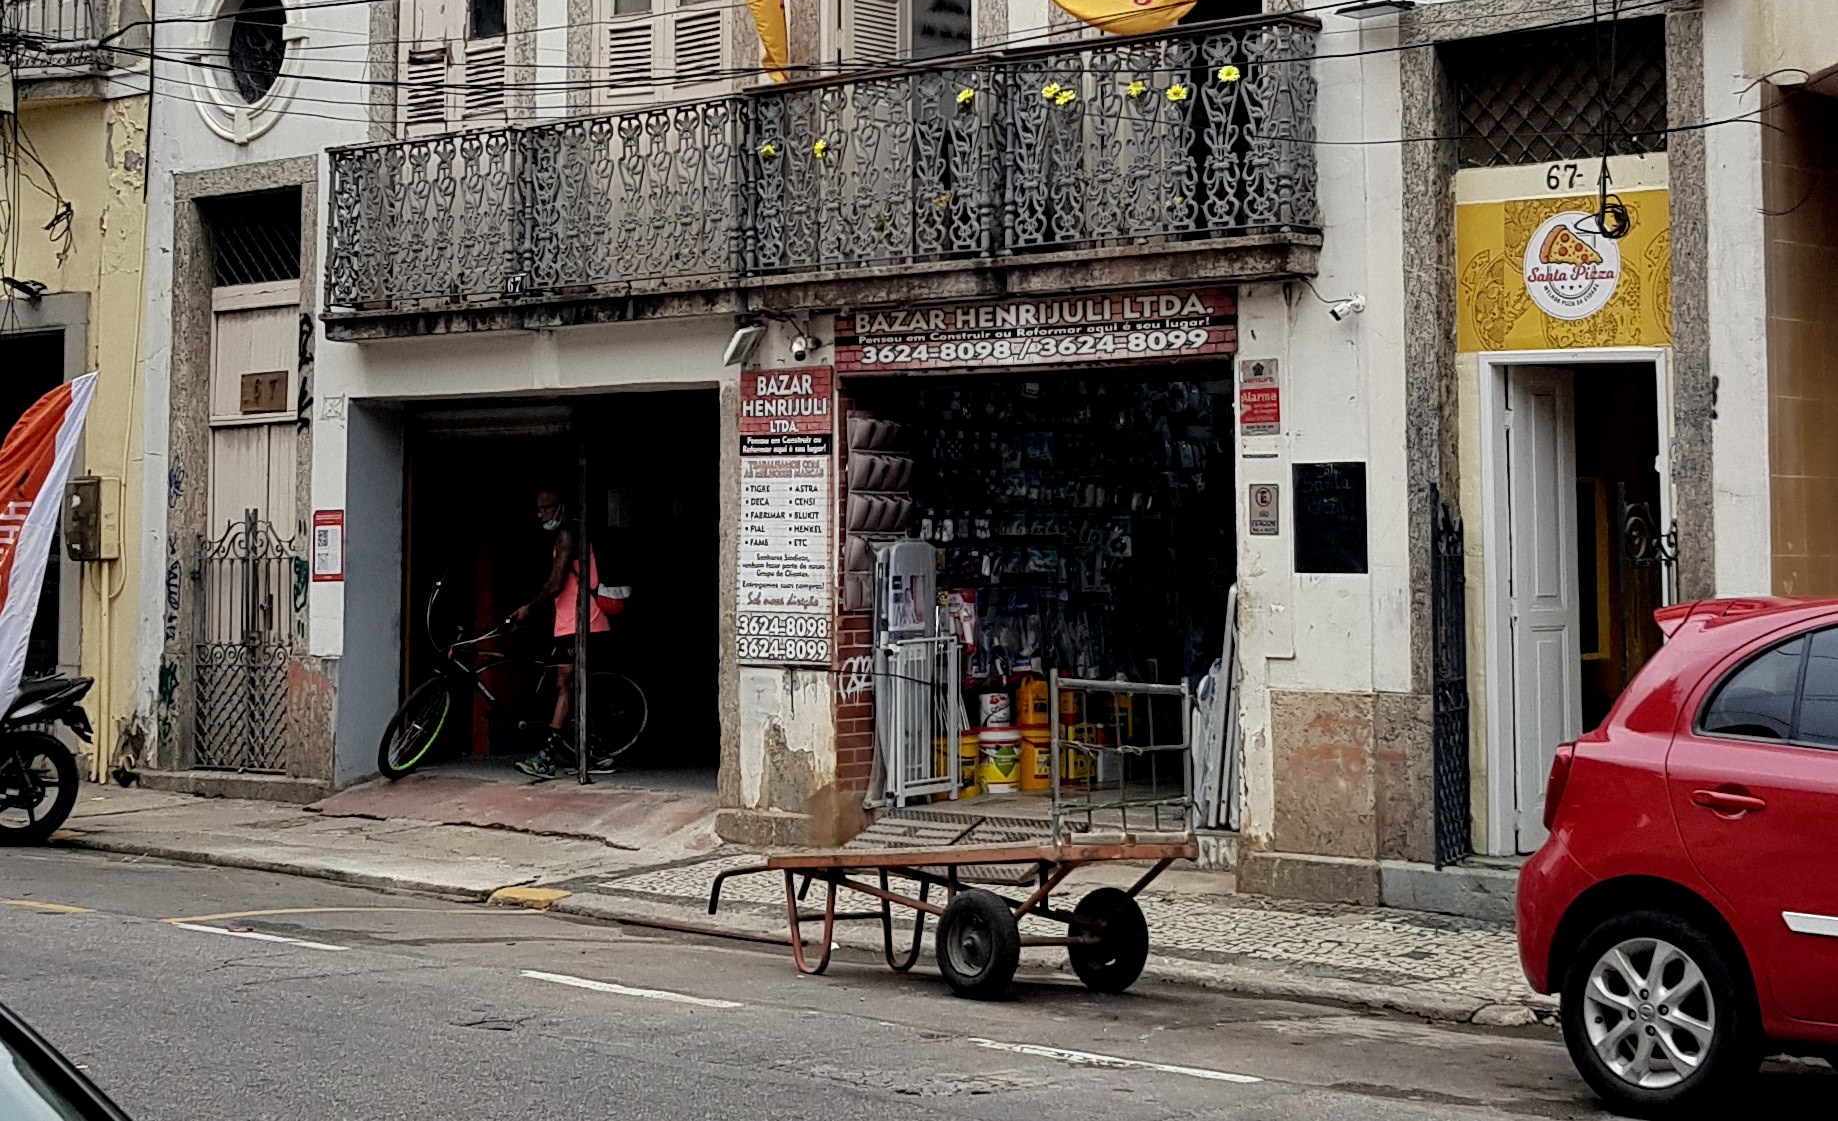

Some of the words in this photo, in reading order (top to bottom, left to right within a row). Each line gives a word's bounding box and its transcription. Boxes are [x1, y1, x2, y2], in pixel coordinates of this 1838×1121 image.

[1527, 266, 1568, 283] Santa
[1570, 265, 1615, 281] Pizza
[855, 309, 947, 334] BAZAR
[956, 299, 1112, 329] HENRIJULI
[1123, 292, 1214, 319] LTDA.
[858, 336, 902, 345] Pensou
[906, 335, 926, 343] em
[929, 330, 990, 341] Construir
[1017, 326, 1083, 337] Reformar
[1087, 320, 1118, 336] aqui
[1122, 321, 1130, 331] é
[1135, 322, 1161, 330] seu
[1165, 317, 1210, 330] lugar!
[861, 340, 1011, 364] 3624-8098
[1039, 329, 1209, 357] 3624-8099
[756, 374, 813, 396] BAZAR
[742, 397, 827, 417] HENRIJULI
[1241, 392, 1277, 402] Alarme
[738, 615, 828, 638] 3624-8098
[738, 637, 828, 661] 3624-8099
